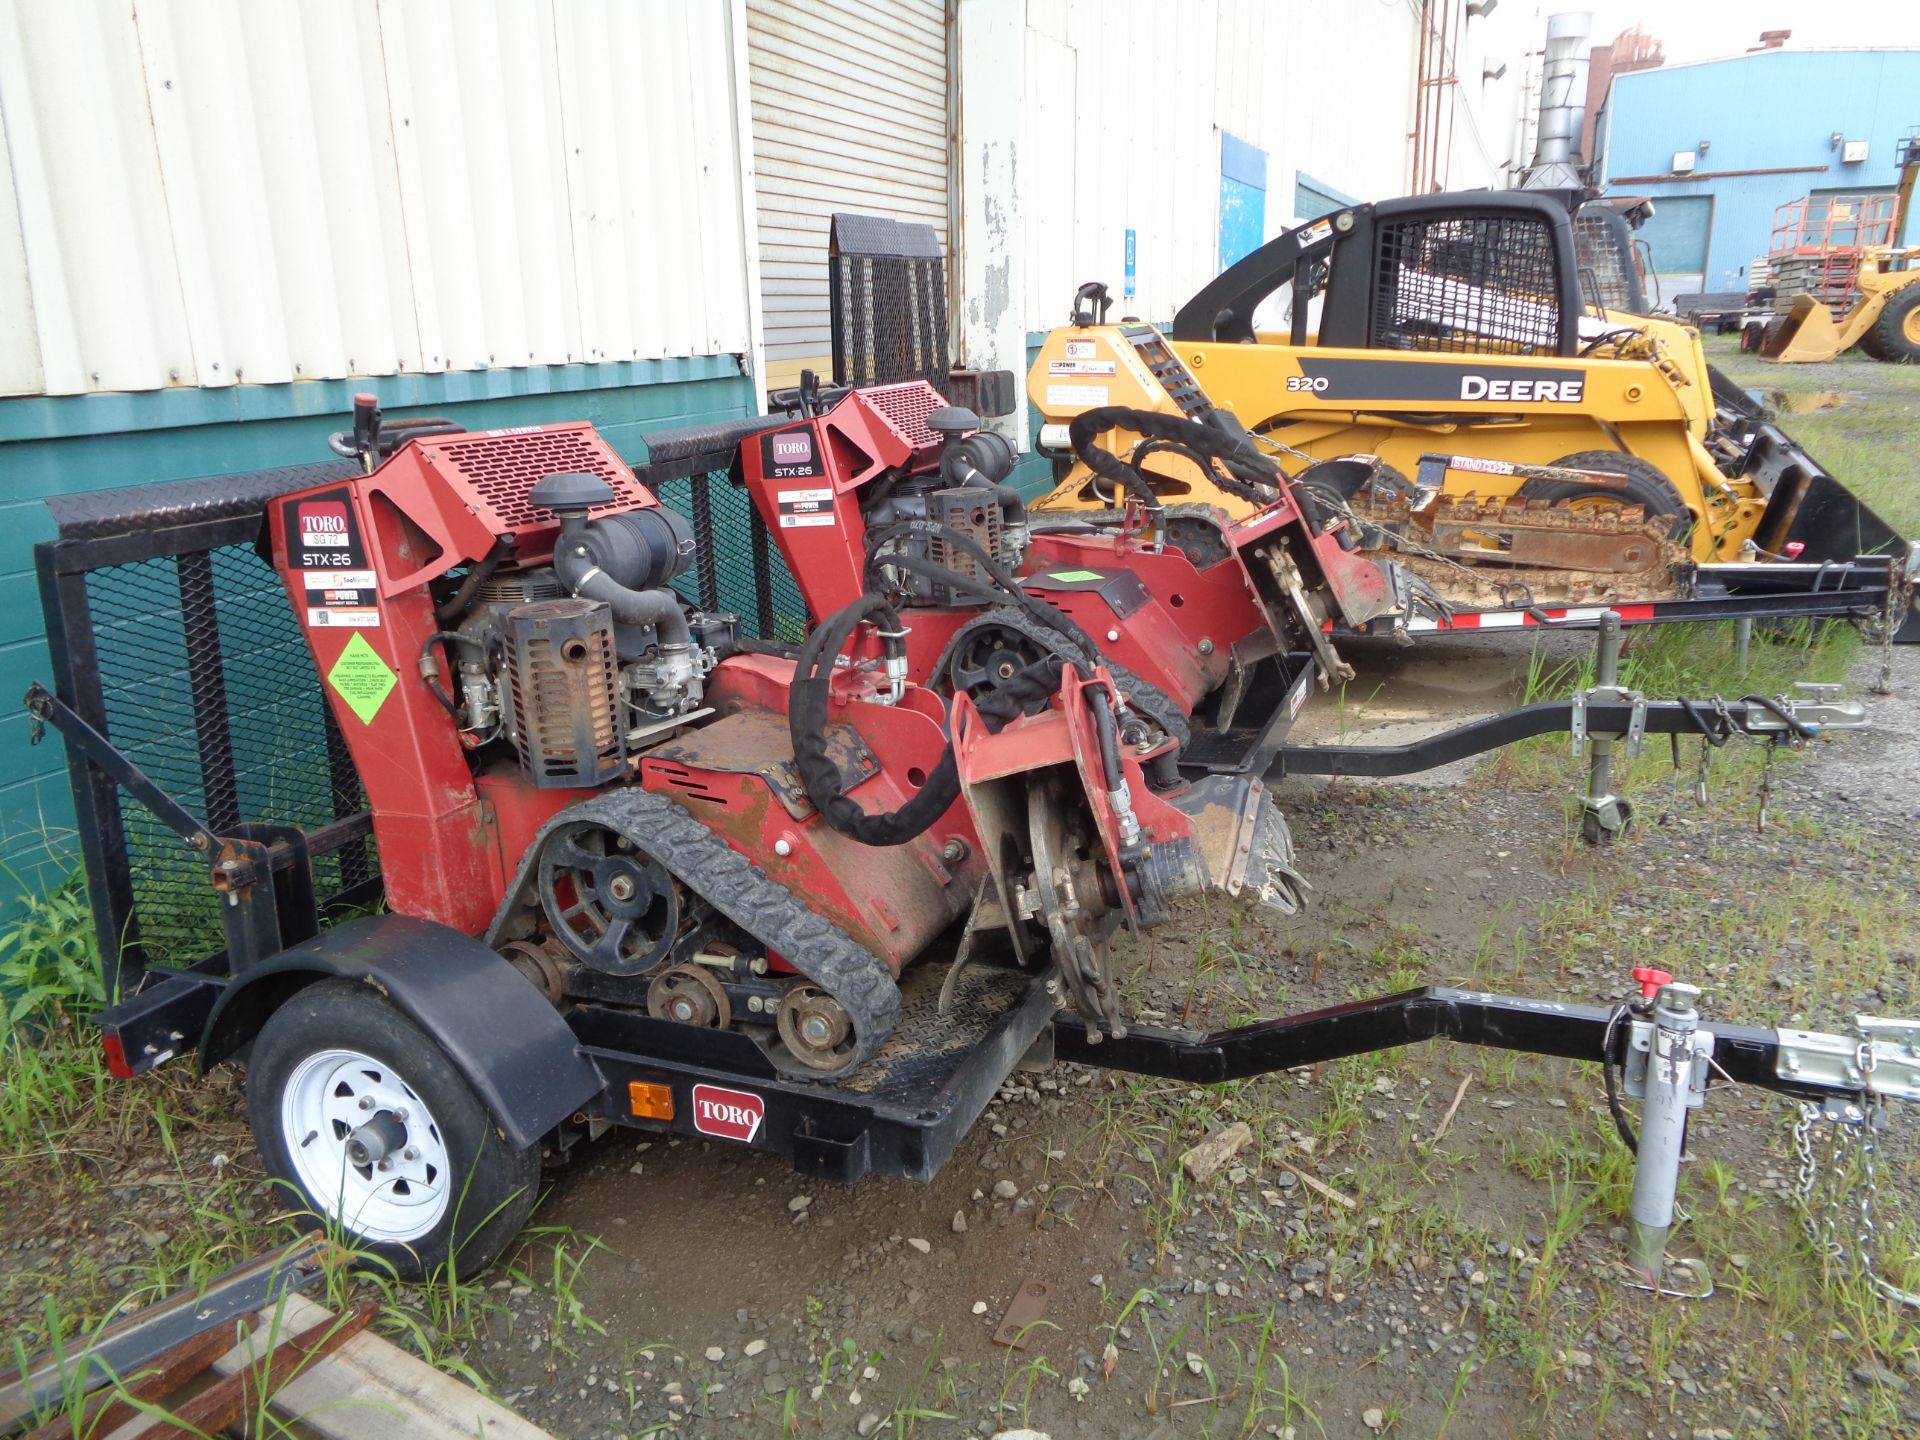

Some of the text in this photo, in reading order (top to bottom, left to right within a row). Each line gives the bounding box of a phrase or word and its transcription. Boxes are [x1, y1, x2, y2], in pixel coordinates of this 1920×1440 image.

[1286, 375, 1583, 403] 320 DEERE
[776, 442, 808, 455] TORO
[303, 515, 345, 533] TORO
[313, 534, 338, 545] SG 72
[335, 590, 358, 600] POWER
[698, 1100, 759, 1127] TORO
